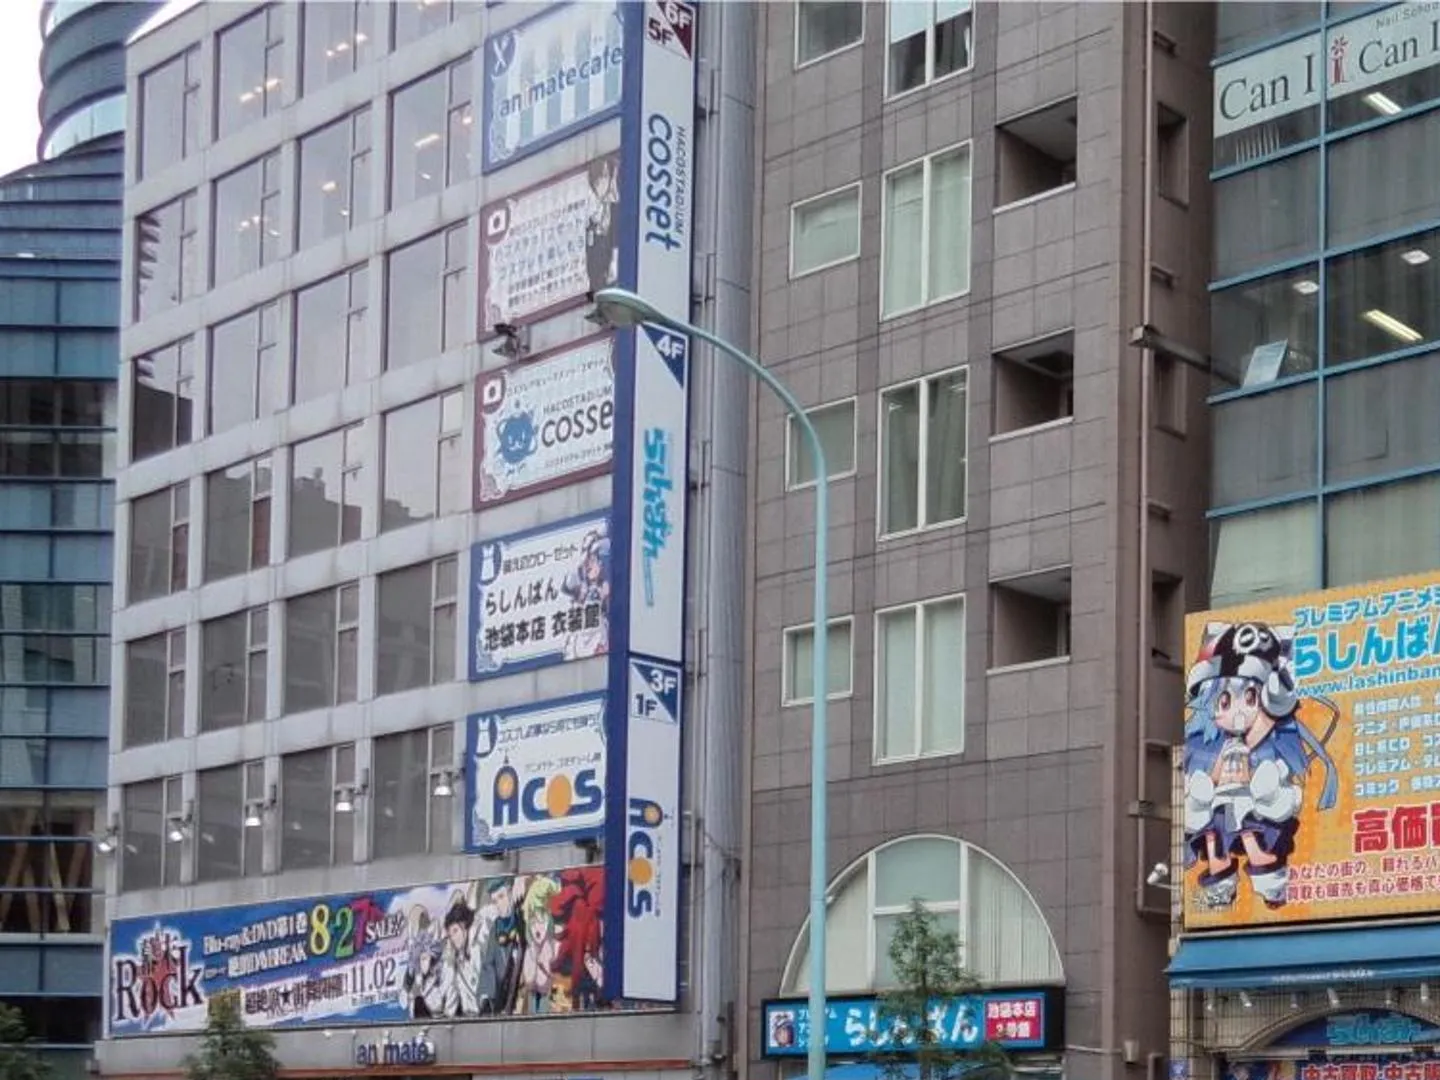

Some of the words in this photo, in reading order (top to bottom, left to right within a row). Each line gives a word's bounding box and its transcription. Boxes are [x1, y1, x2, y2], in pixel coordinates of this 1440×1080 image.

[664, 2, 692, 28] 6F
[647, 17, 674, 44] 5F
[1220, 70, 1290, 120] Can
[1304, 53, 1316, 94] I
[1358, 32, 1419, 75] Can
[1431, 19, 1440, 52] I
[657, 334, 683, 358] 4F
[484, 577, 560, 616] らしんばん
[484, 616, 546, 651] 池袋本店
[551, 603, 600, 637] 衣装館
[651, 668, 677, 695] 3F
[634, 693, 658, 717] 1F
